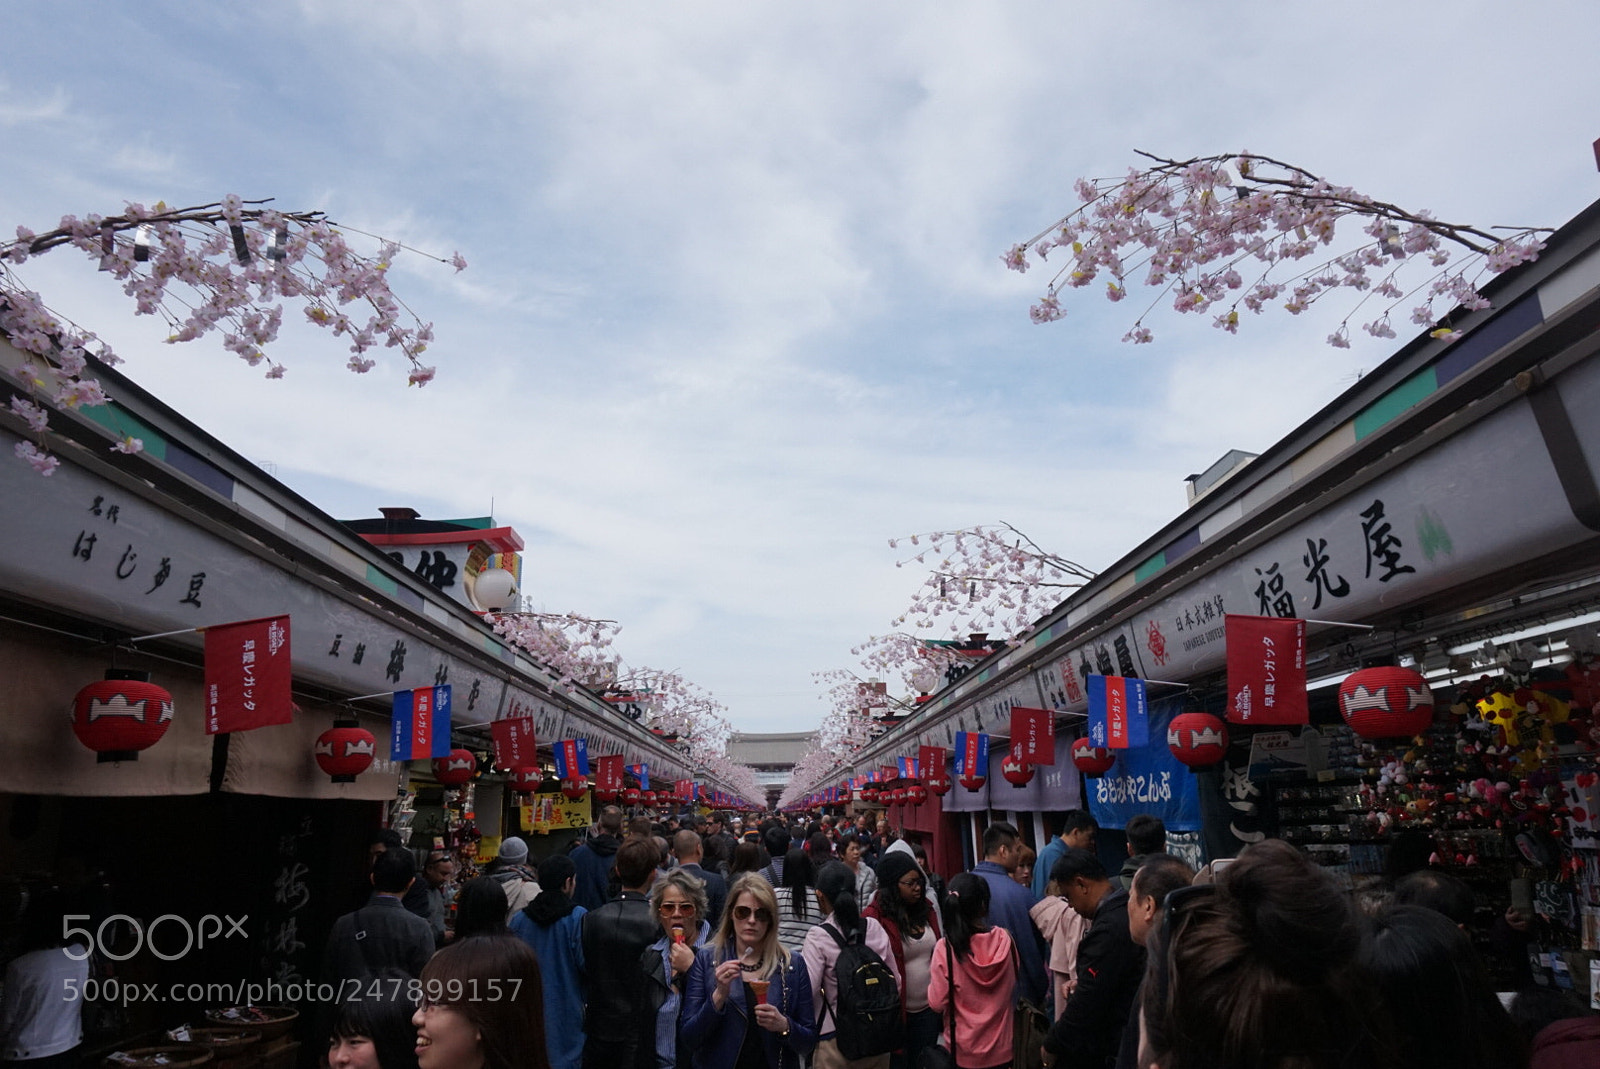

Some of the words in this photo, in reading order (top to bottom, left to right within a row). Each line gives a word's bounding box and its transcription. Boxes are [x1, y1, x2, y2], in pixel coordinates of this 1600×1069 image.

[1254, 499, 1416, 619] 福光屋
[1096, 771, 1172, 804] おおみやこんぶ
